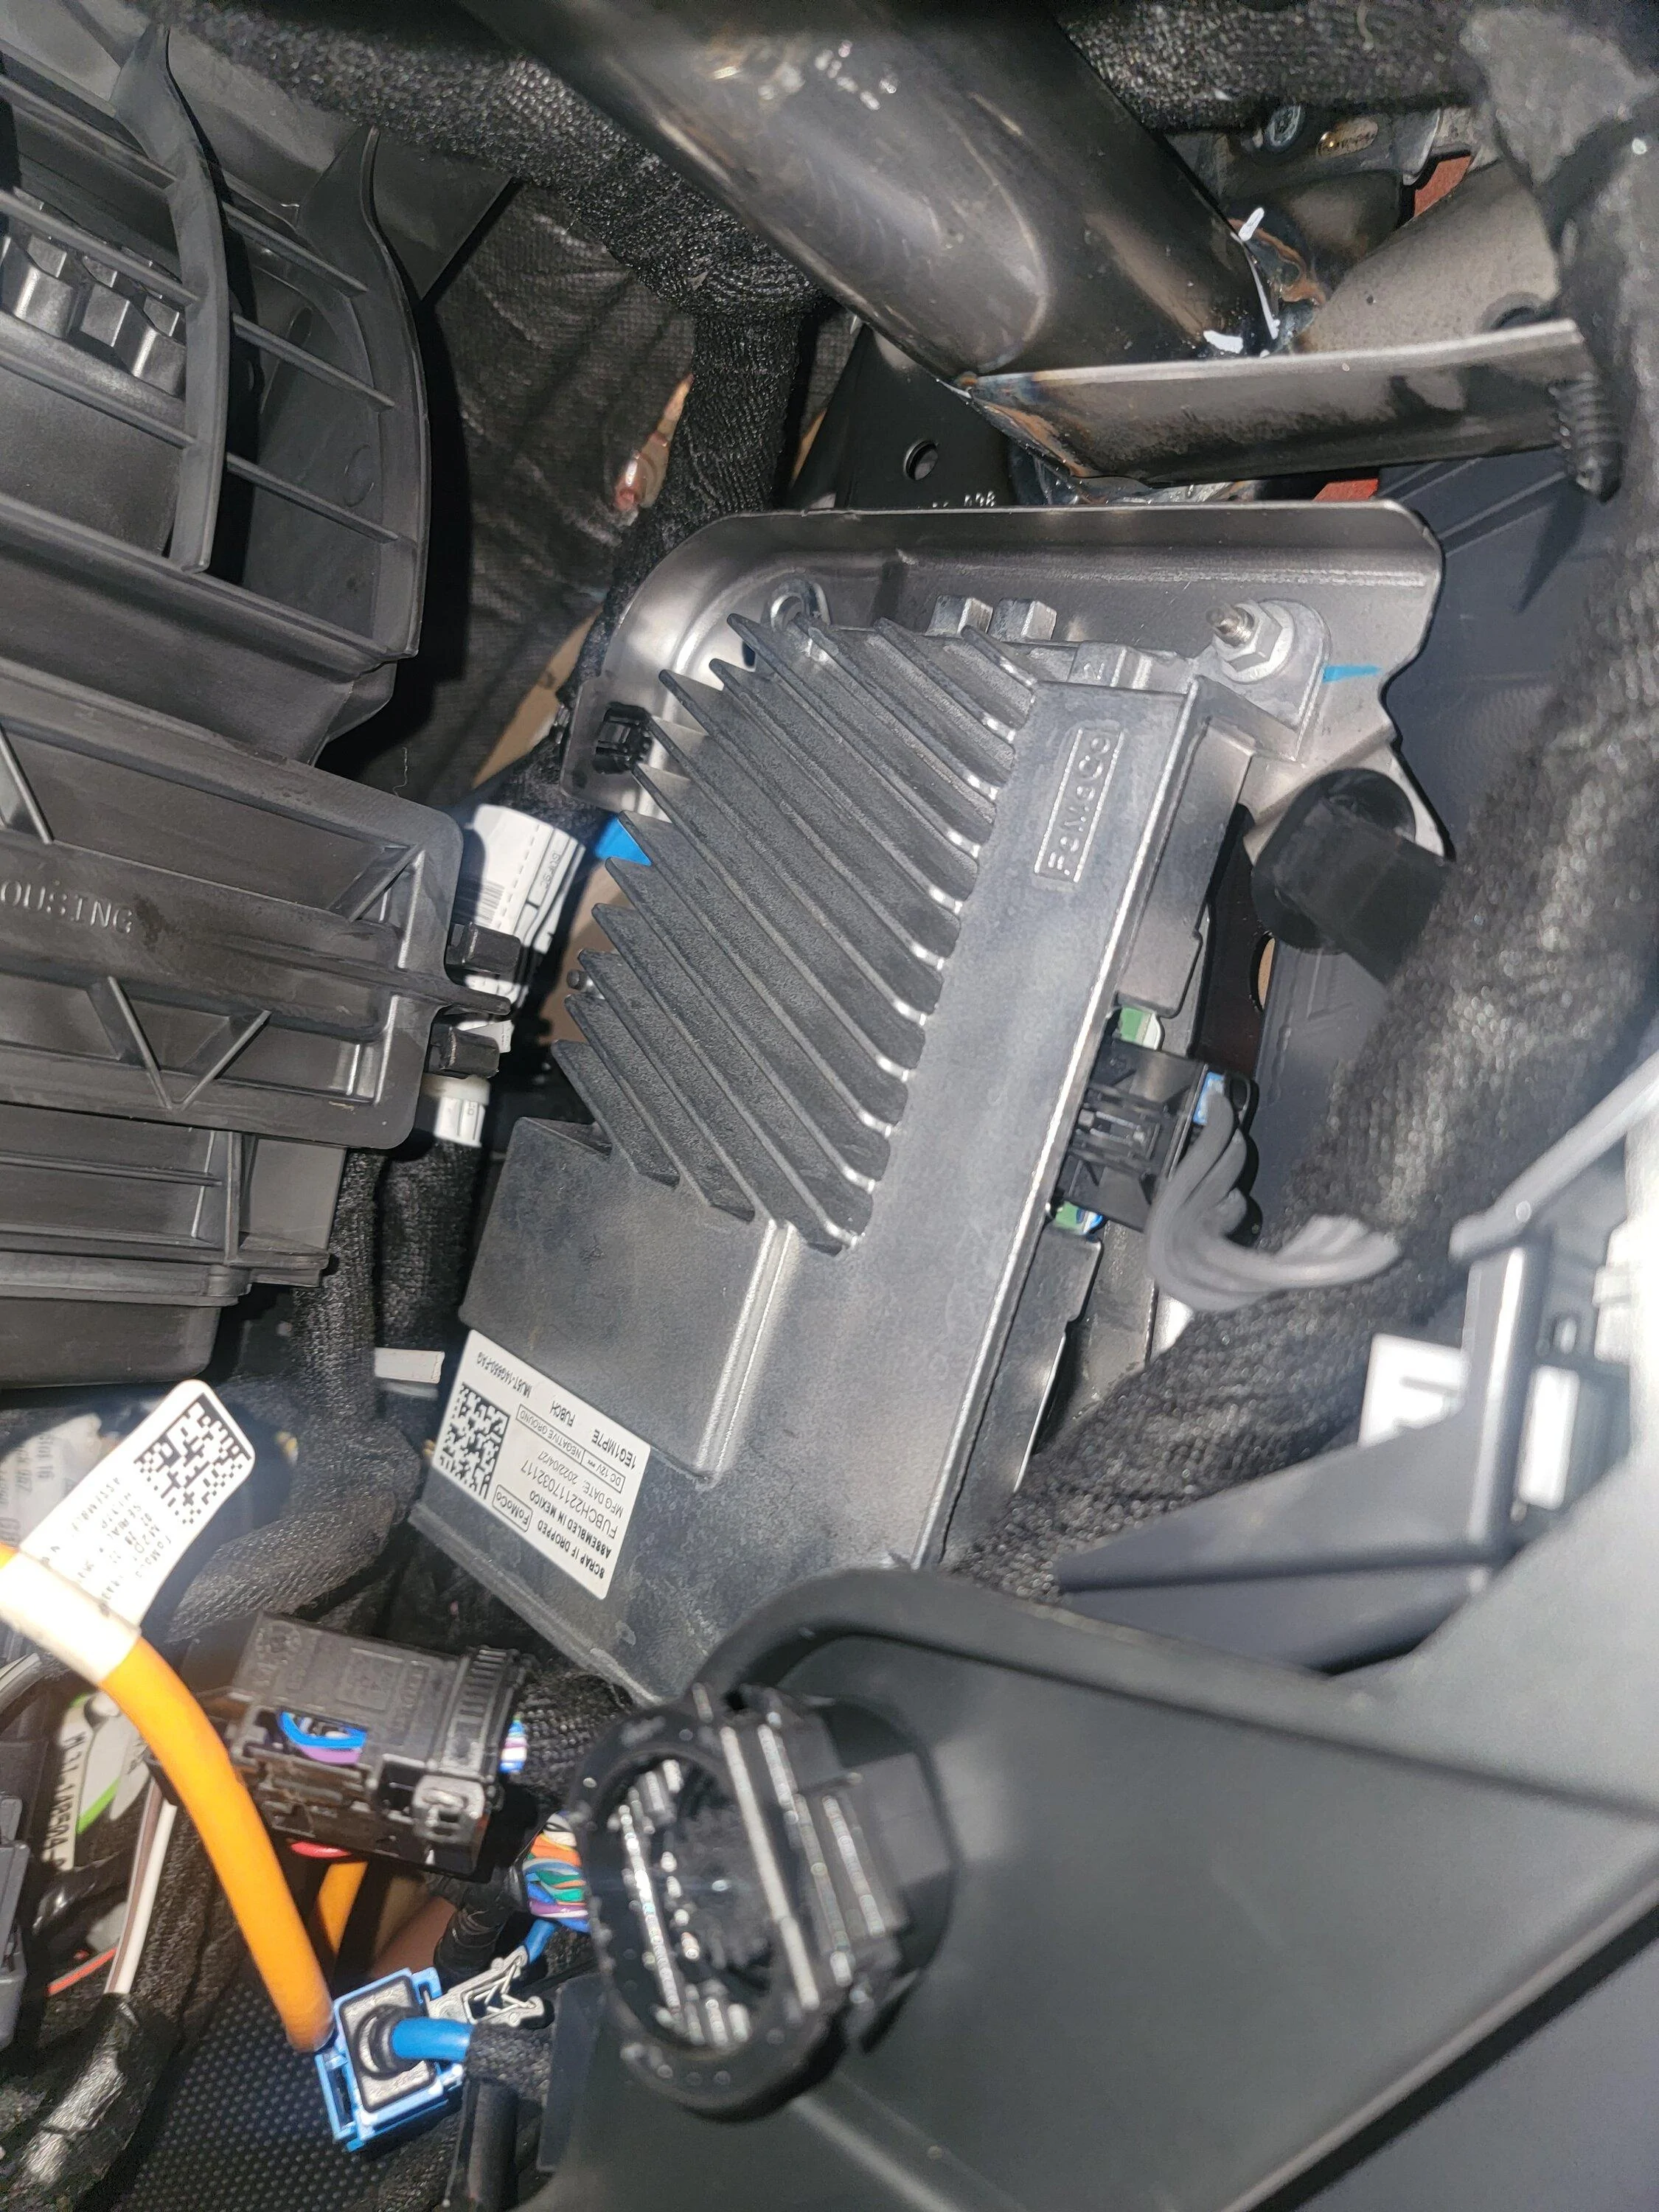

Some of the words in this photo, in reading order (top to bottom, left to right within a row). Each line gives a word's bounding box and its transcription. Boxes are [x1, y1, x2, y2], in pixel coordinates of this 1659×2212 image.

[519, 1408, 549, 1436] GROUND
[547, 1428, 582, 1458] NEGATIVE
[537, 1447, 579, 1486] 2022/04/27
[596, 1462, 610, 1478] 12V
[608, 1471, 622, 1486] DC
[495, 1489, 529, 1525] FoMoCo
[529, 1489, 557, 1518] MEXICO
[604, 1495, 624, 1518] MFG
[557, 1510, 567, 1526] IN
[536, 1518, 571, 1552] DROPPED
[571, 1545, 580, 1559] IF
